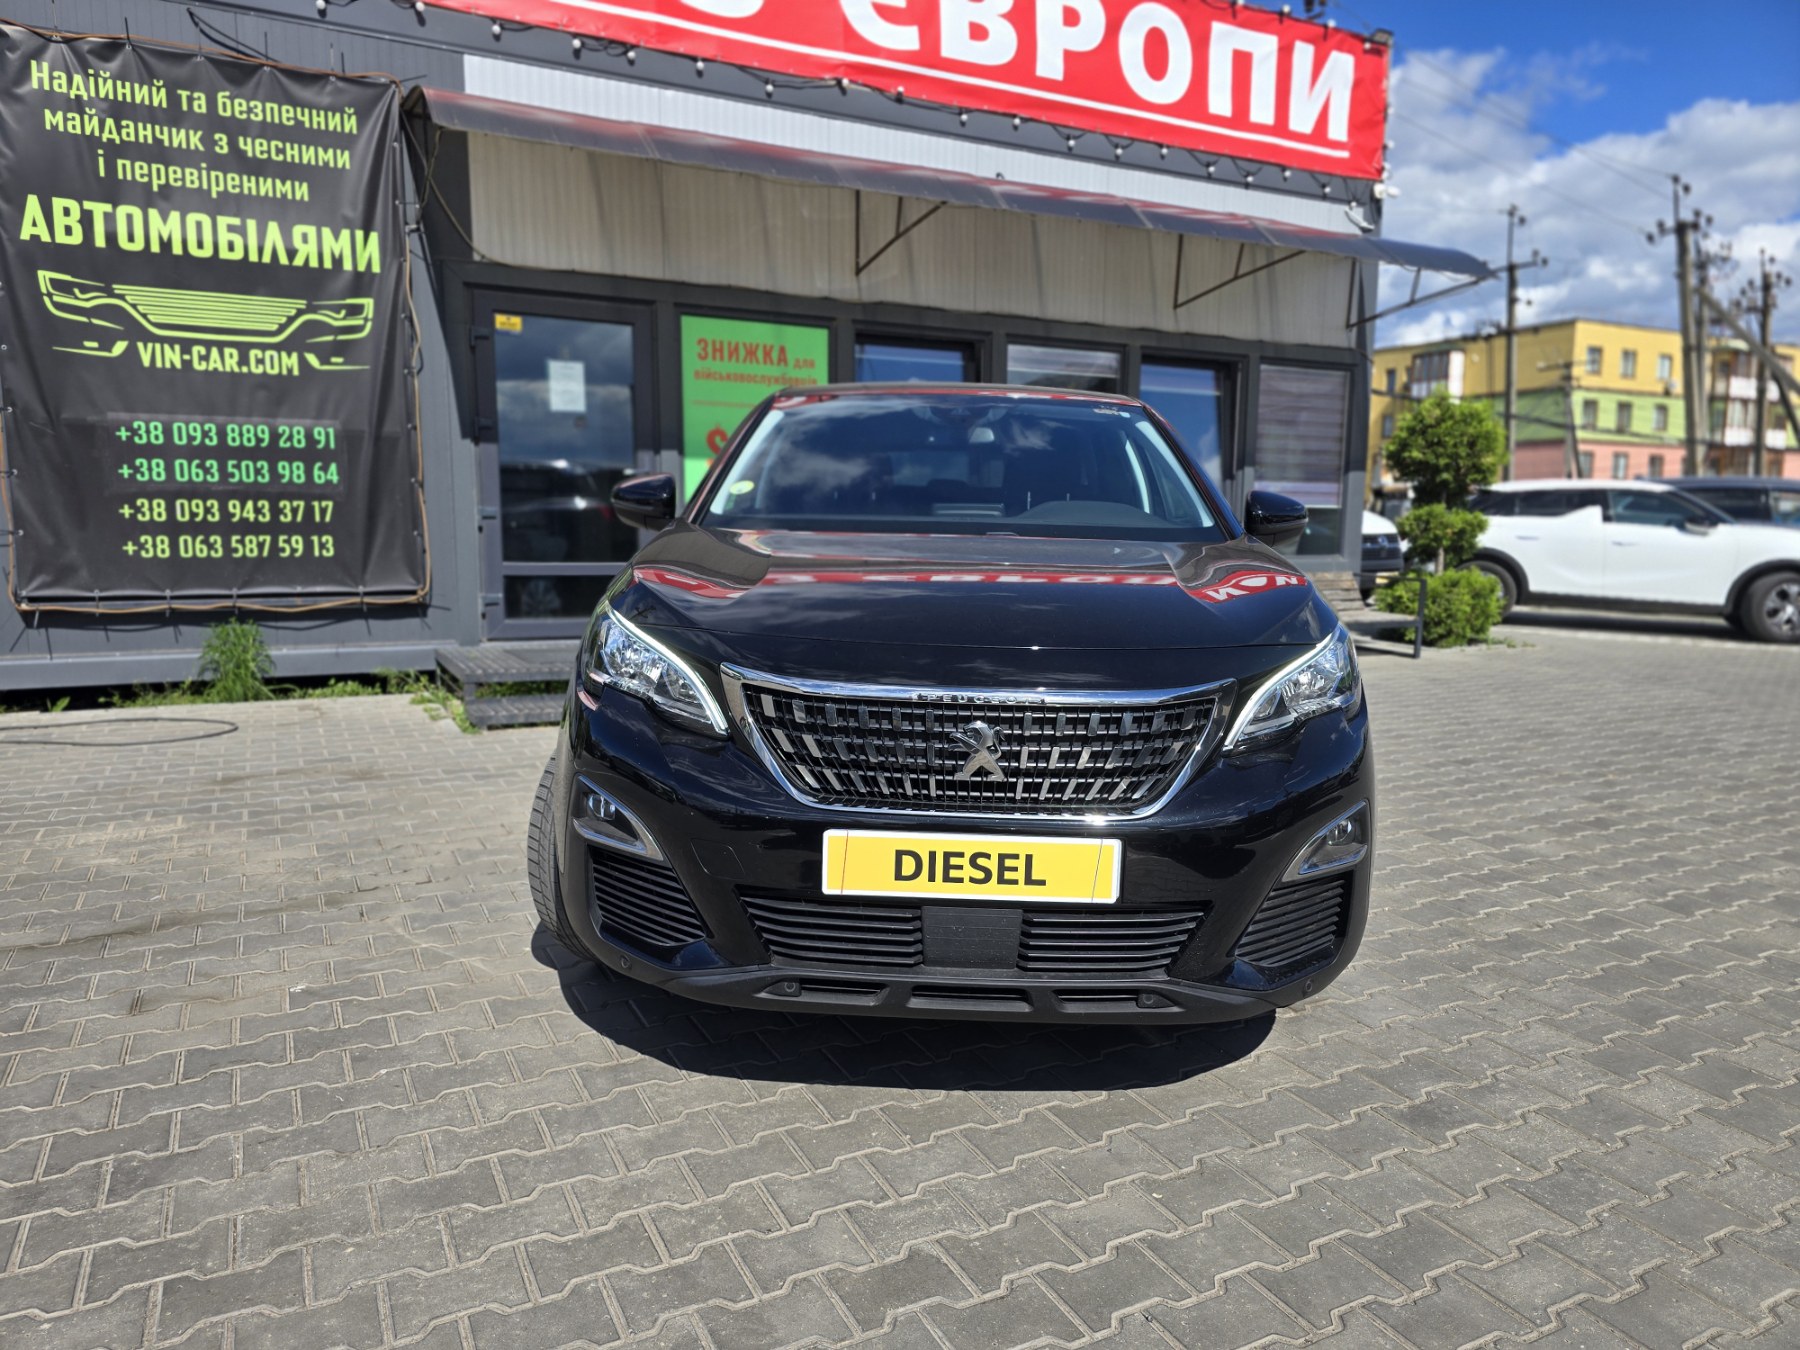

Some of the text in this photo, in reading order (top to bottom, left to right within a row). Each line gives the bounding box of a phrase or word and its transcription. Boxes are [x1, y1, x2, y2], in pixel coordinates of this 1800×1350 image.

[30, 59, 358, 135] Надійний та безпечний
[43, 106, 351, 170] майданчик з чесними
[97, 149, 310, 202] і перевіреними
[19, 193, 381, 274] АВТОМОБІЛЯМИ
[136, 341, 300, 376] VIN-CAR.COM
[696, 337, 789, 368] ЗНИЖКА
[115, 420, 336, 450] +38 093 889 28 91
[117, 457, 340, 485] +38 063 503 98 64
[118, 497, 334, 523] +38 093 943 37 17
[122, 534, 335, 559] +38 063 587 59 13
[893, 849, 1047, 887] DIESEL
